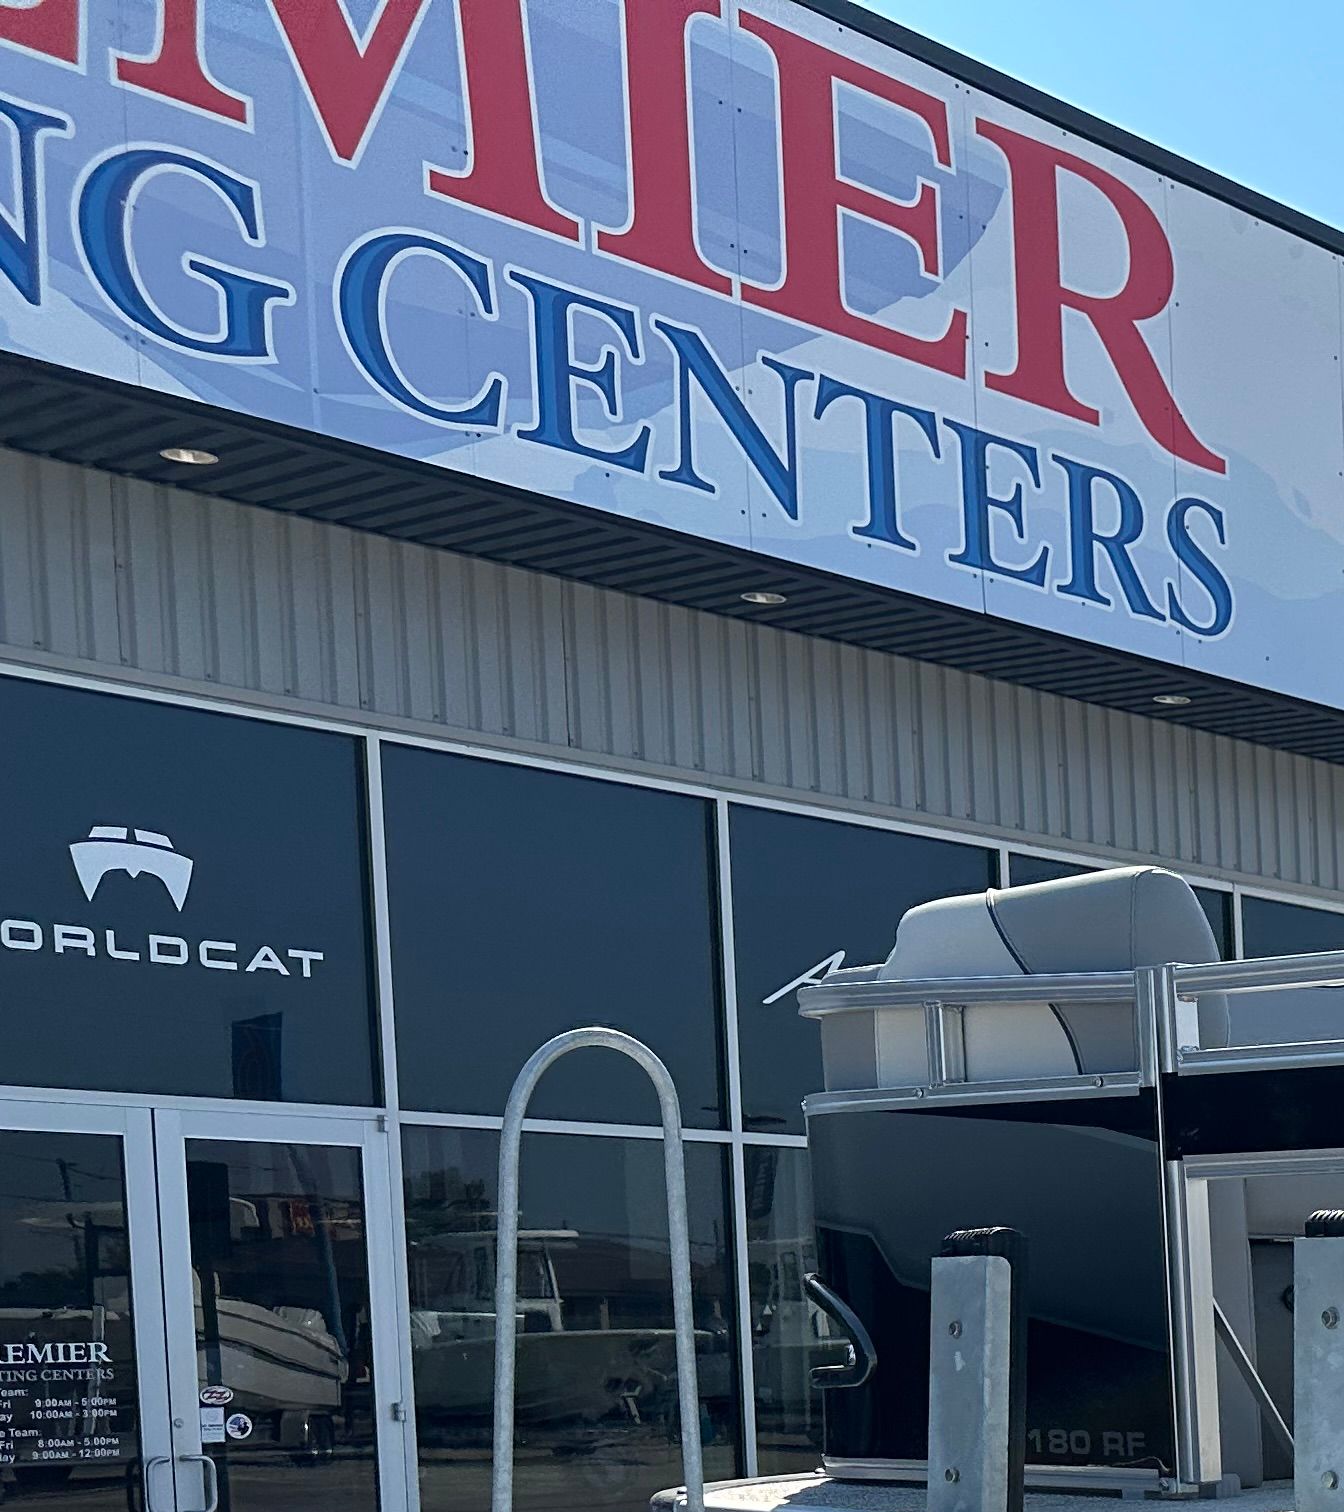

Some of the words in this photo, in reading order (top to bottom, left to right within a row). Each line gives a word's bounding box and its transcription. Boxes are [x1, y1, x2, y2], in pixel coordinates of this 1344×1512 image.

[0, 0, 1229, 476] MIER
[336, 230, 1235, 640] CENTERS
[0, 918, 325, 978] ORLDCAT
[0, 1341, 114, 1364] EMIER
[41, 1368, 115, 1381] CENTERS
[0, 1388, 29, 1398] eam:
[1102, 1430, 1147, 1457] RF
